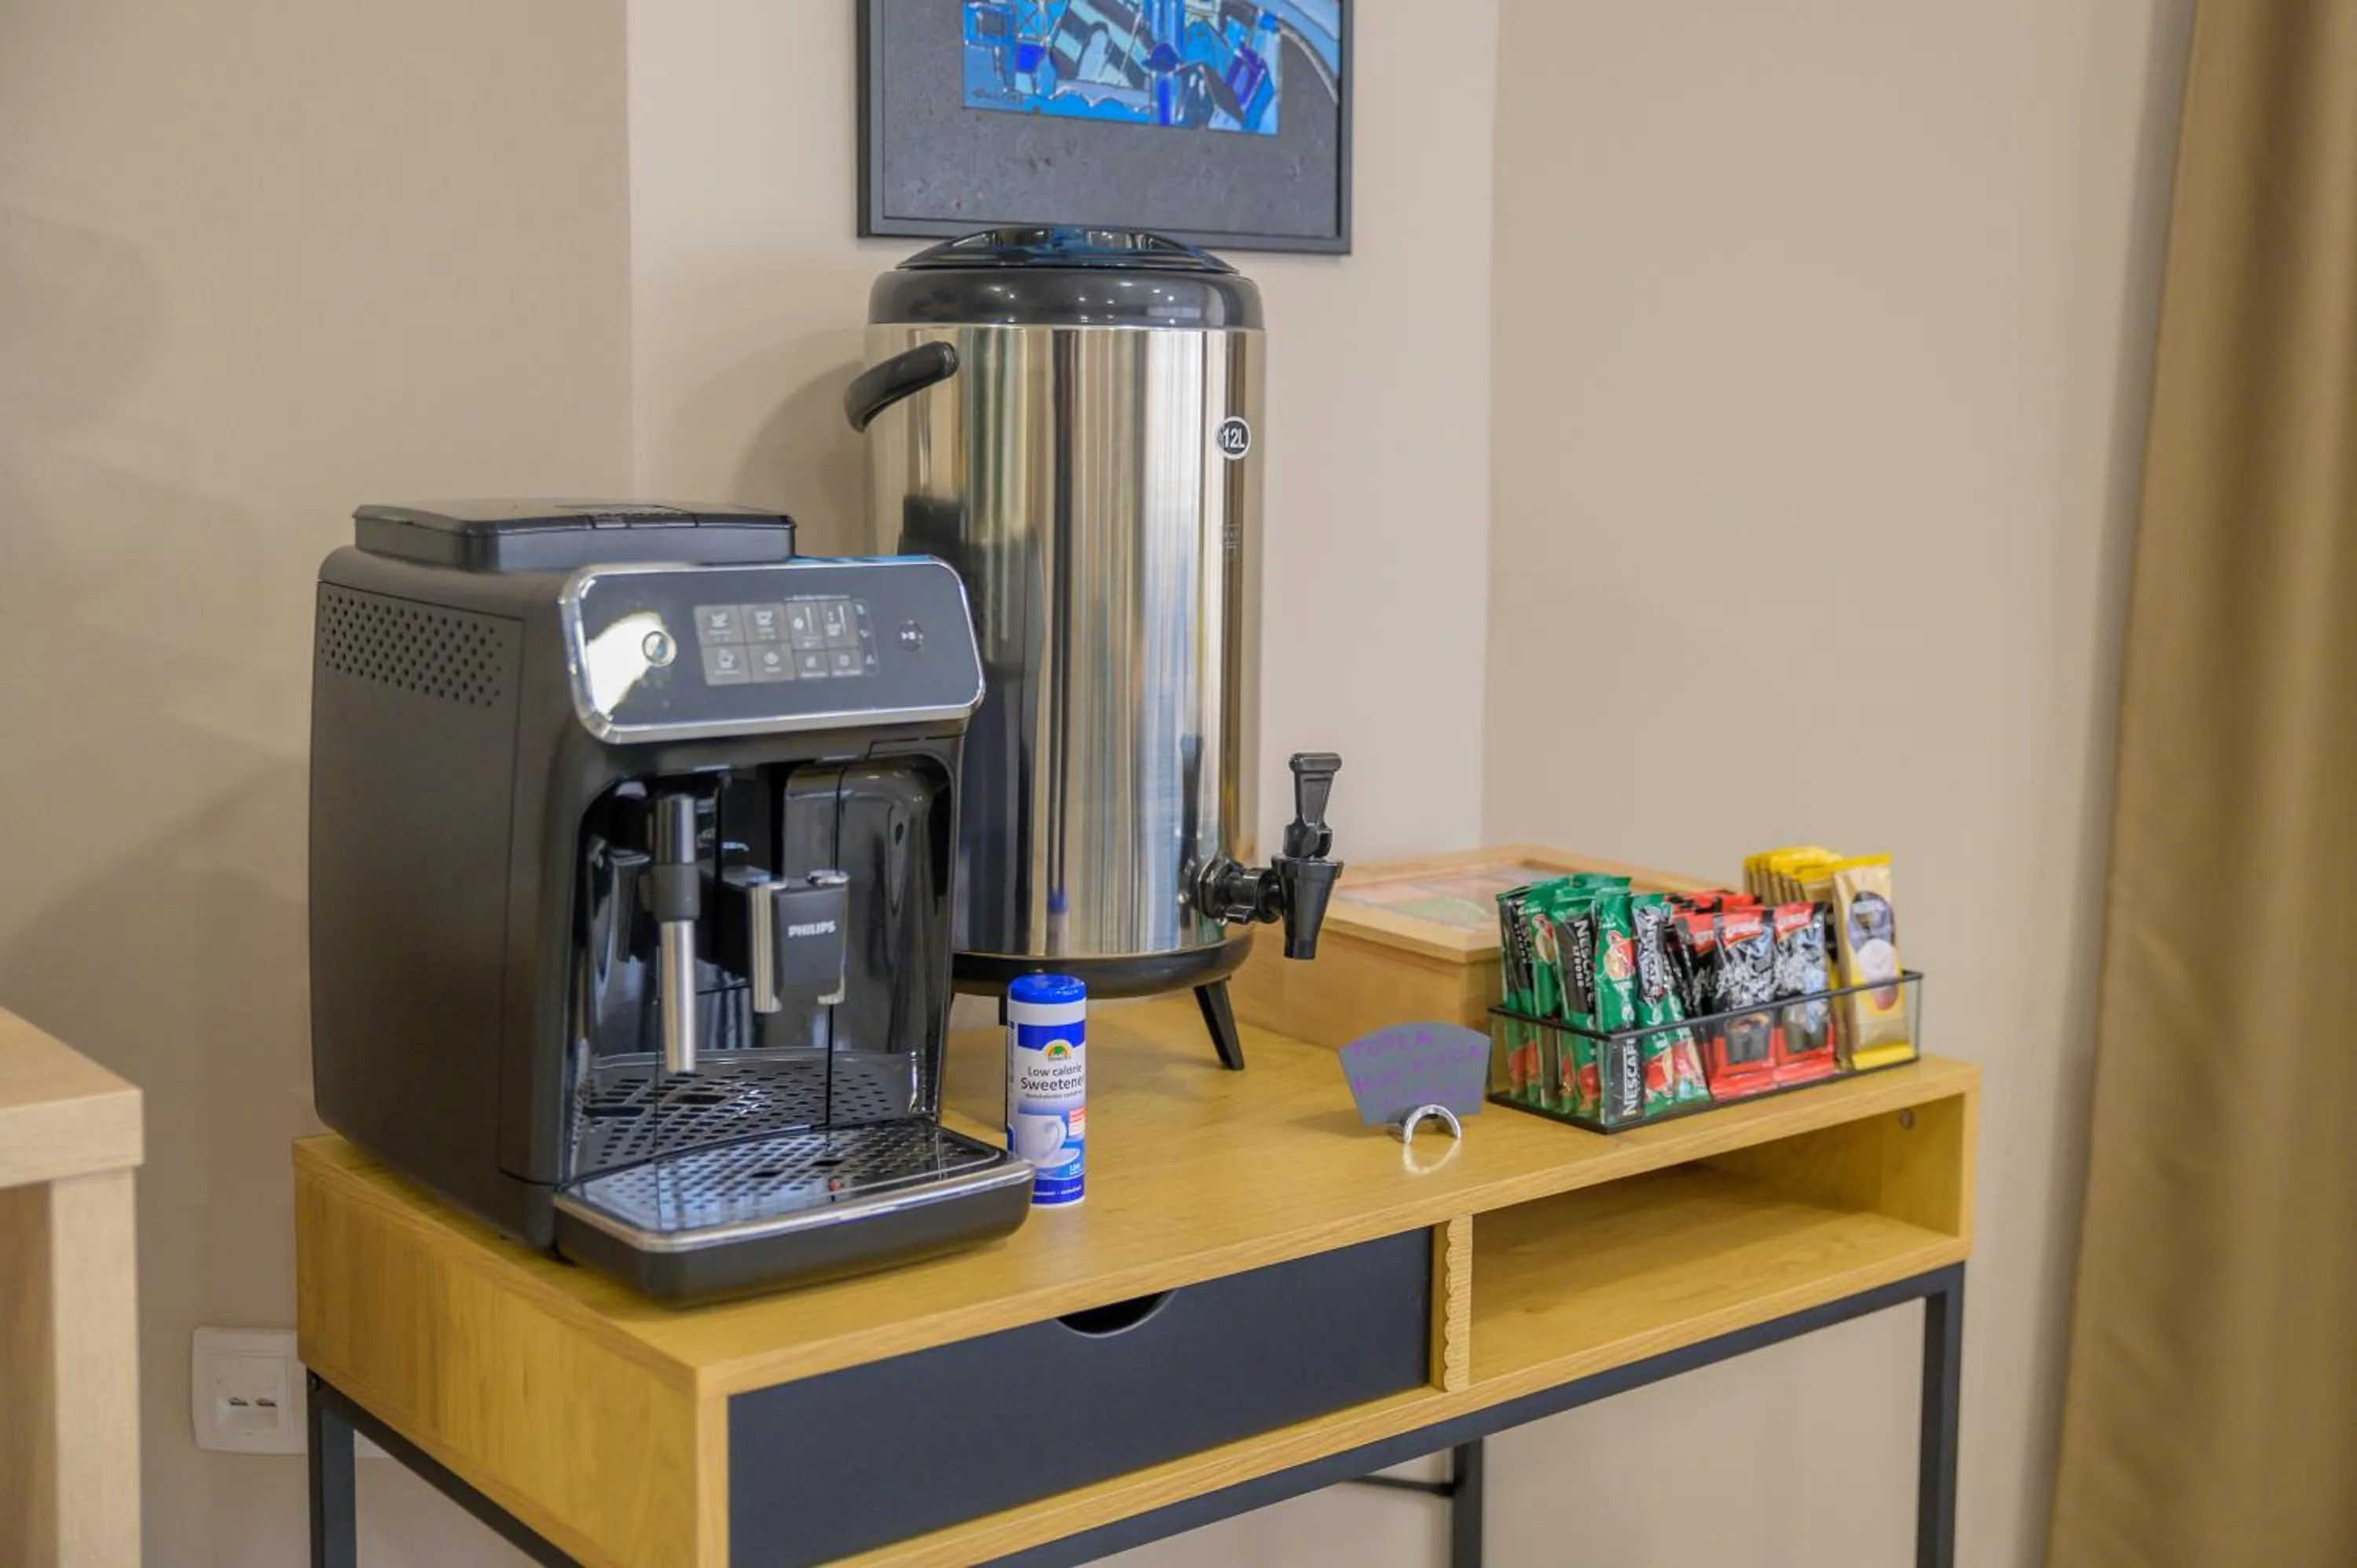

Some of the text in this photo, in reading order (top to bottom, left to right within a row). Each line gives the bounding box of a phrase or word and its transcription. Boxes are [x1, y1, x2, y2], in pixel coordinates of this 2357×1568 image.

[1223, 427, 1245, 448] 12L
[788, 920, 836, 937] PHILIPS
[1028, 1066, 1050, 1077] Low
[1021, 1075, 1083, 1091] Sweetene
